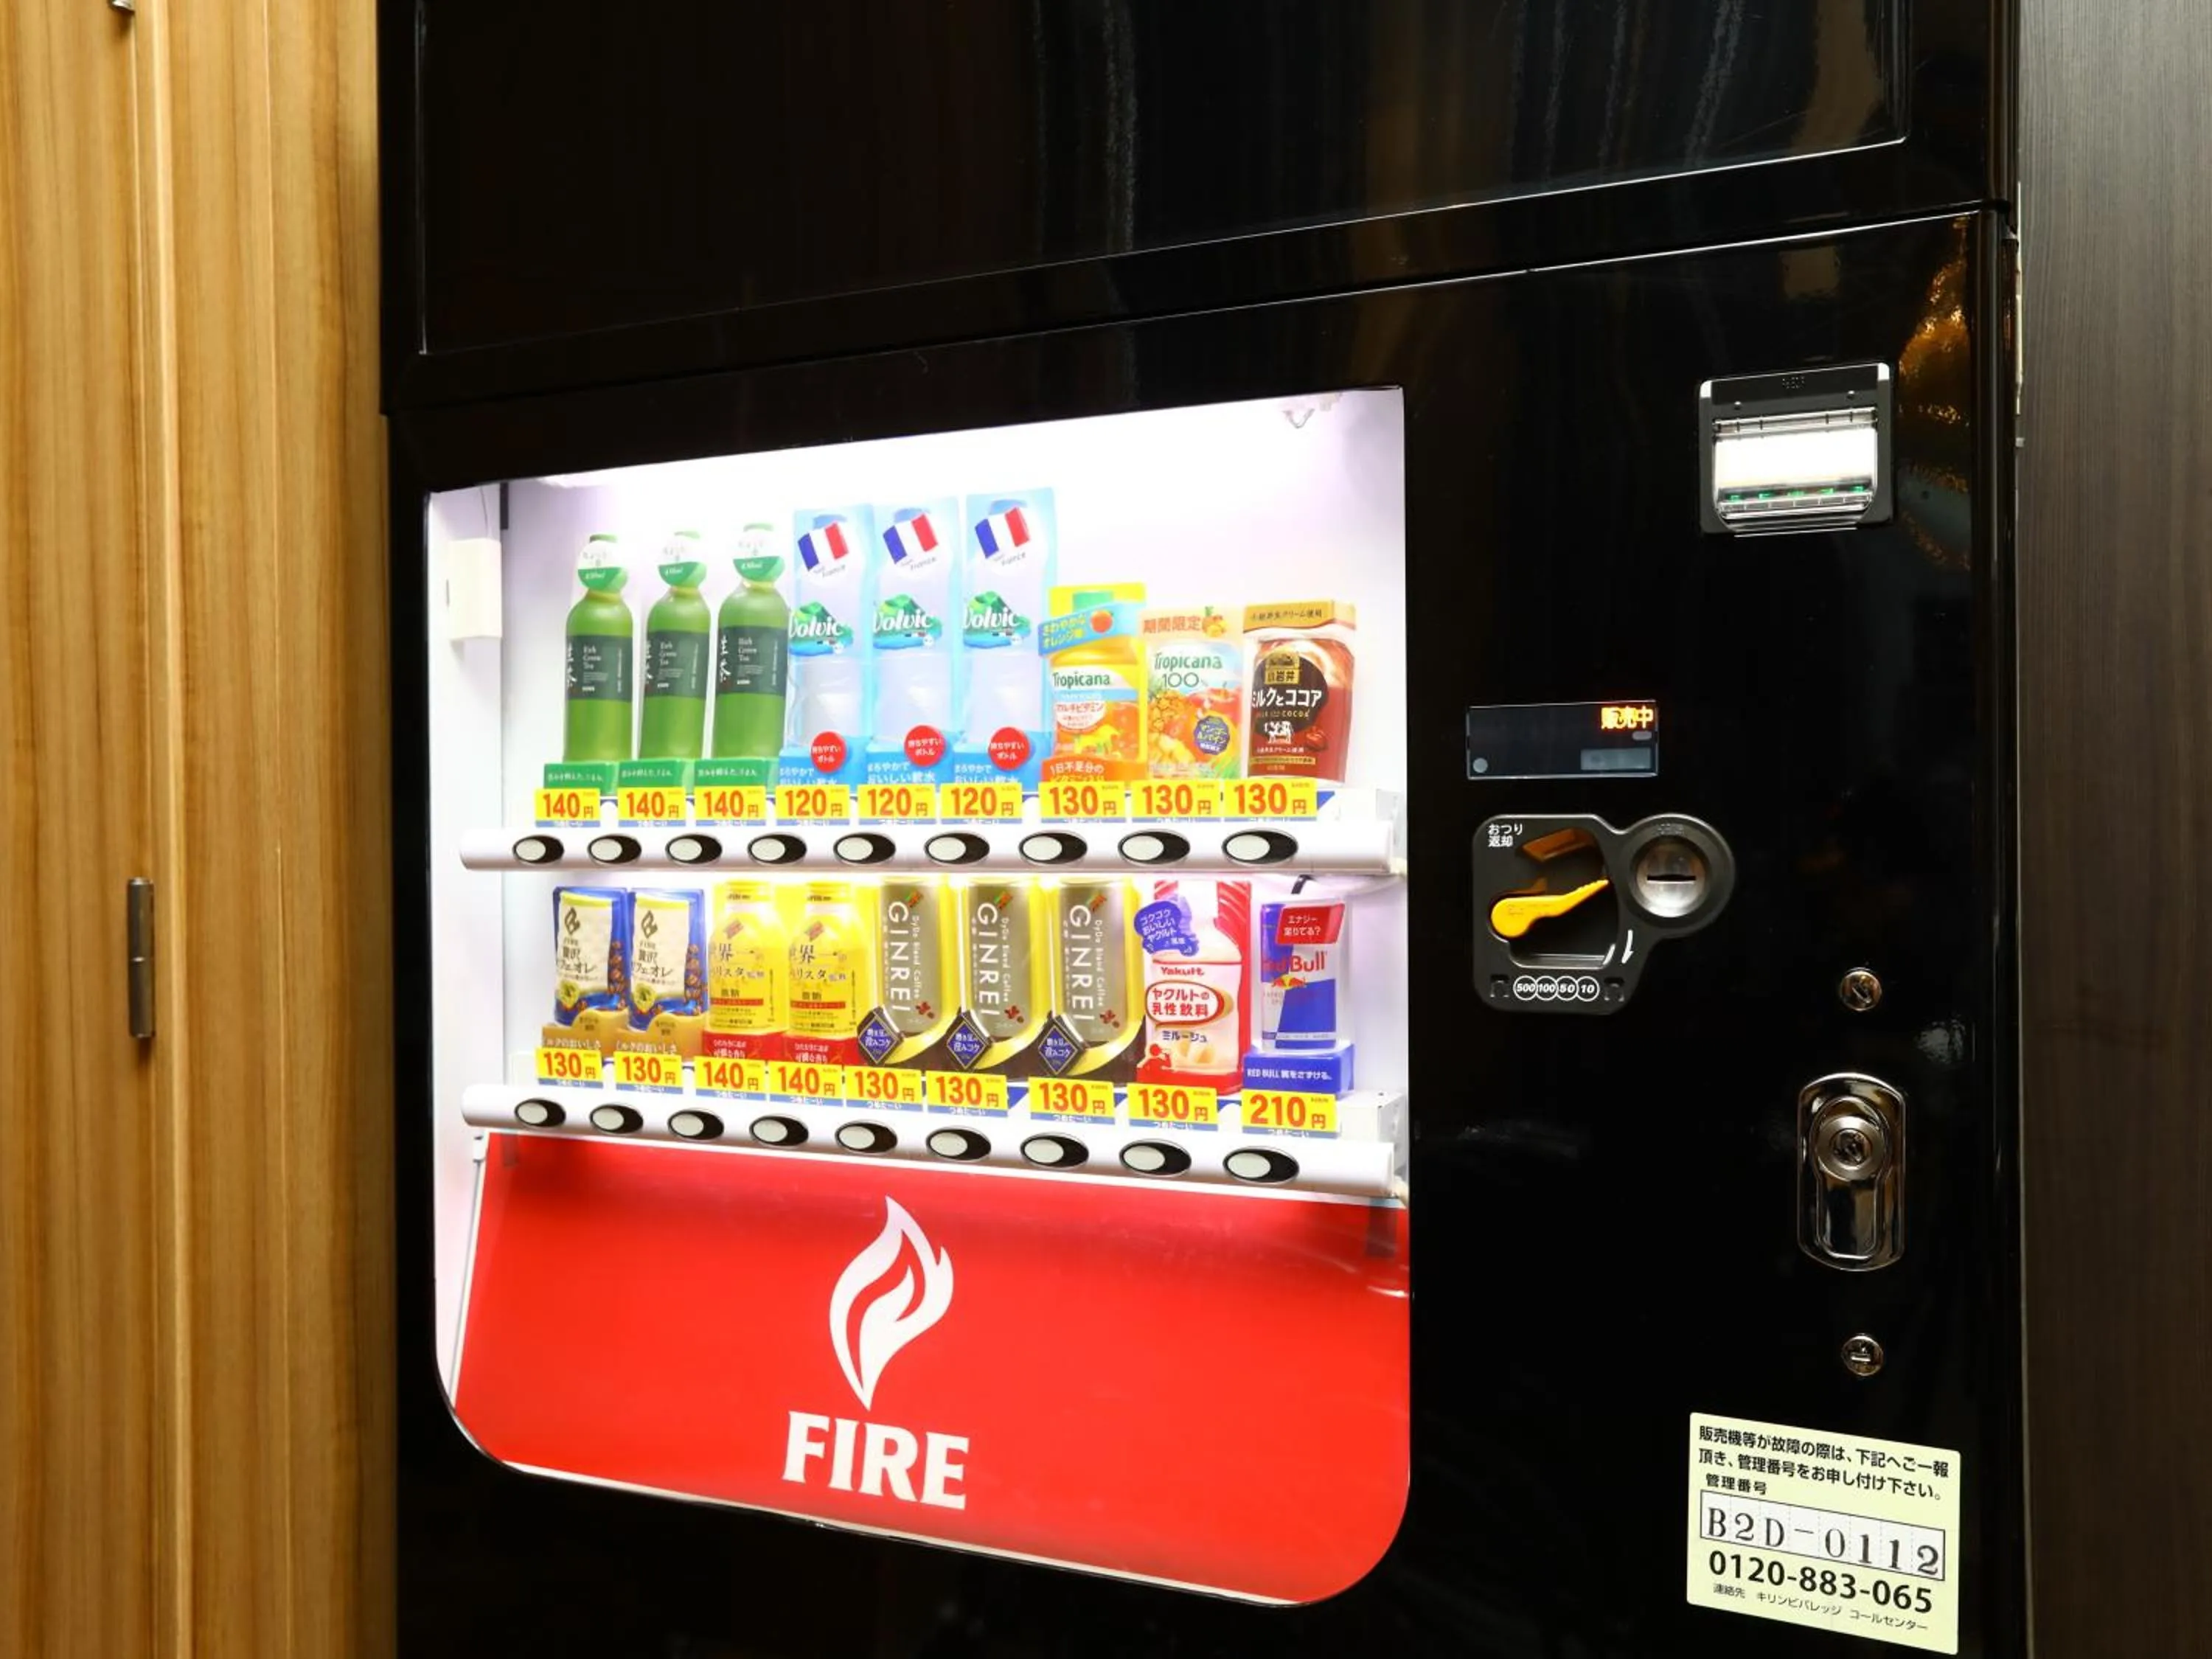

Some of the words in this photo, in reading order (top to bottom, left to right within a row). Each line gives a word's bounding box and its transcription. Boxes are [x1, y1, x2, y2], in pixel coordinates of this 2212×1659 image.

[788, 614, 844, 638] Volvic
[873, 608, 933, 633] Volvic
[964, 605, 1022, 629] Volvic
[1154, 652, 1223, 672] Tropicana
[1052, 671, 1110, 688] Tropicana
[1251, 687, 1322, 708] ミルクとココア
[1600, 706, 1654, 729] 販売中
[1487, 823, 1523, 835] おつり
[1487, 835, 1513, 849] 返却
[887, 901, 911, 1012] GINREI
[977, 902, 1001, 1015] GINREI
[1070, 904, 1096, 1021] GINREI
[1290, 950, 1325, 973] Bull
[1160, 967, 1204, 976] Yakult
[1152, 987, 1210, 1001] ヤクルトの
[1516, 982, 1536, 992] 500
[1537, 983, 1557, 993] 100
[1559, 983, 1575, 993] 50
[1581, 984, 1594, 994] 10
[1152, 1002, 1208, 1017] 乳性飲料
[1162, 1030, 1208, 1043] ミルージュ
[1247, 1068, 1262, 1077] RED
[782, 1409, 970, 1510] FIRE
[1699, 1425, 1949, 1478] 販売機等が故障の際は、下記へご一報
[1699, 1447, 1942, 1501] 頂き、管理番号をお申し付け下さい。
[1705, 1473, 1767, 1495] 管理番号
[1708, 1506, 1939, 1576] B2D-0112
[1708, 1550, 1933, 1614] 0120-883-065
[1713, 1582, 1745, 1599] 連絡先
[1848, 1609, 1929, 1630] コールセンター
